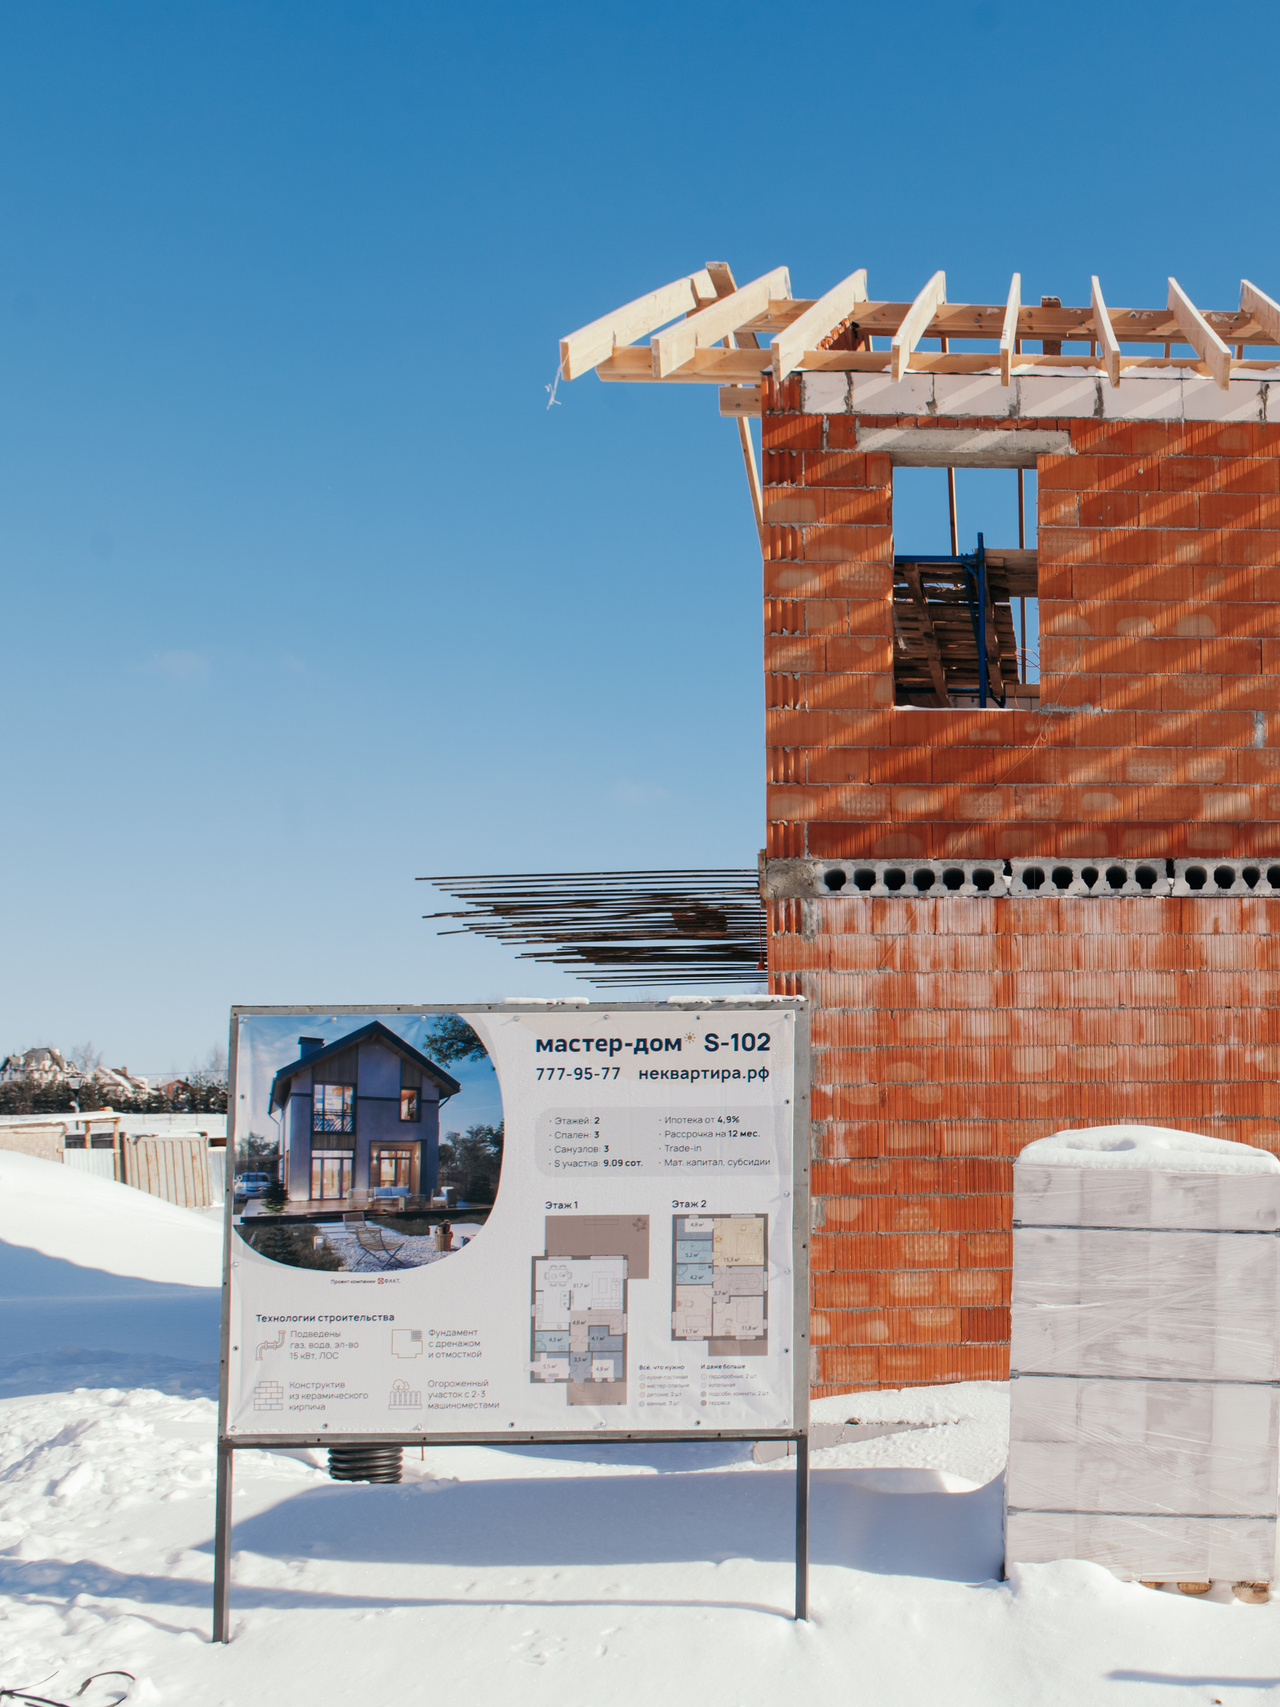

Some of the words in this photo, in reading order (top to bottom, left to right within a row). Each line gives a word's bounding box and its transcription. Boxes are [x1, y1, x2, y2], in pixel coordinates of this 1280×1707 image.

[536, 1036, 682, 1057] мастер-дом
[704, 1033, 770, 1052] S-102
[536, 1067, 621, 1081] 777-95-77
[639, 1067, 769, 1082] неквартира.рф
[555, 1116, 592, 1125] Этажей:
[665, 1116, 703, 1124] Ипотека
[717, 1116, 739, 1125] 4,9%
[555, 1130, 592, 1139] Спален:
[665, 1130, 713, 1139] Рассрочка
[728, 1130, 738, 1138] 12
[555, 1145, 601, 1154] Санузлов:
[665, 1144, 702, 1152] Trade-in
[562, 1160, 600, 1169] участка:
[604, 1159, 623, 1167] 9.09
[727, 1158, 770, 1167] субсидии
[574, 1201, 578, 1209] 1
[672, 1200, 699, 1208] Этаж
[256, 1314, 315, 1322] Технологии
[318, 1314, 394, 1323] строительства
[291, 1331, 341, 1339] Подведены
[429, 1329, 478, 1338] Фундамент
[435, 1340, 480, 1349] дренажом
[290, 1381, 345, 1390] Конструктив
[428, 1379, 489, 1389] Огороженный
[301, 1392, 368, 1401] керамического
[428, 1391, 462, 1400] участок
[472, 1390, 485, 1398] 2-3
[289, 1403, 326, 1412] кирпича
[428, 1402, 499, 1410] машиноместами
